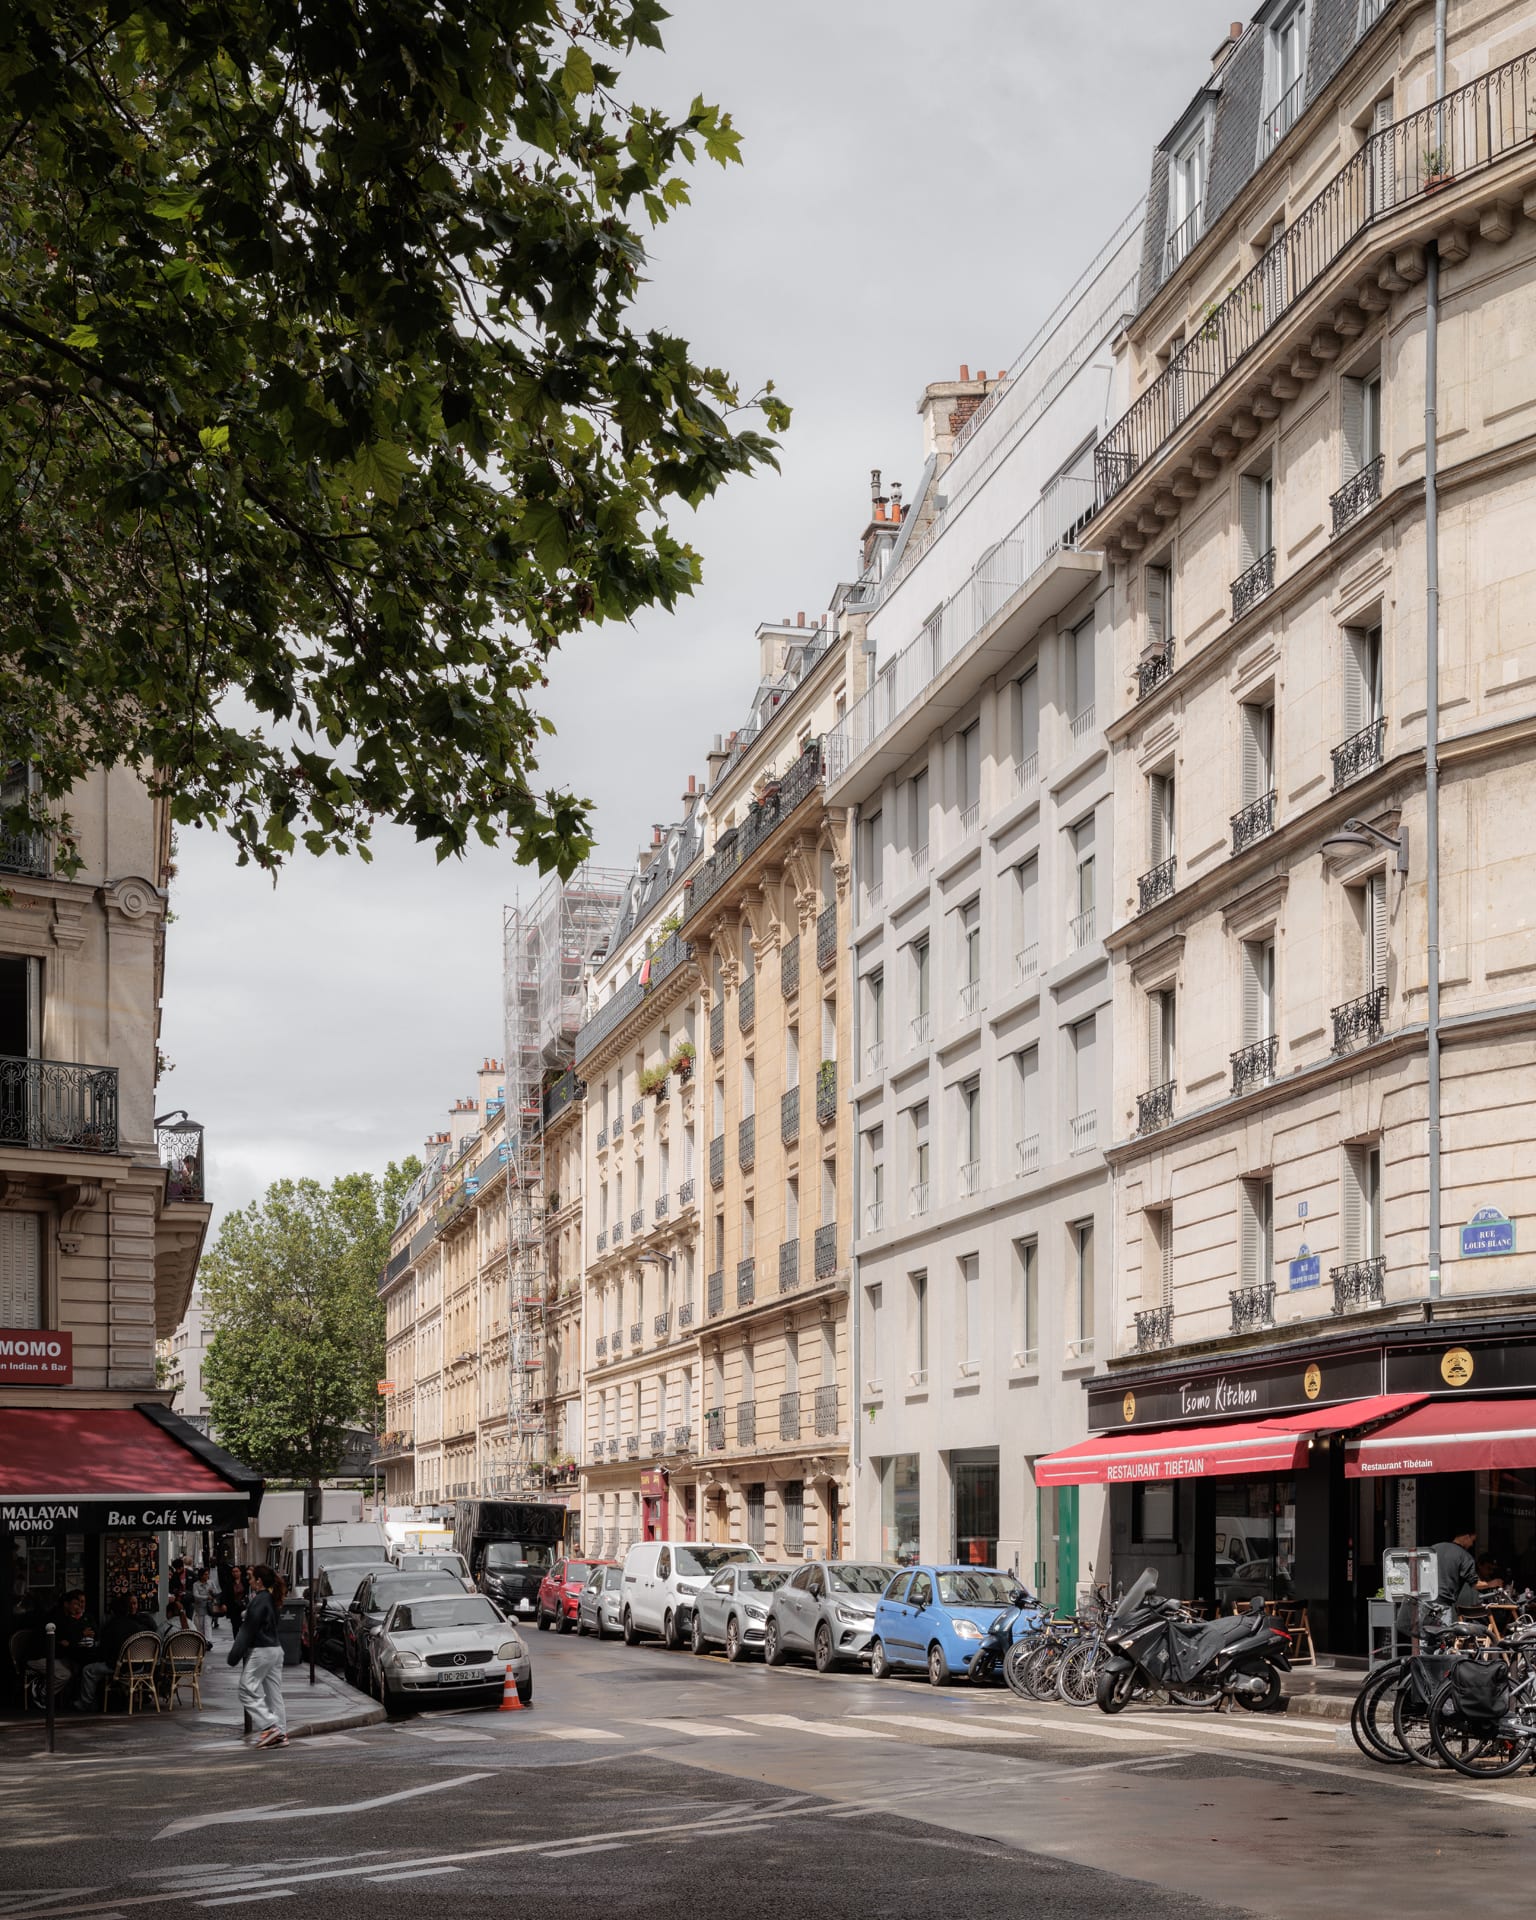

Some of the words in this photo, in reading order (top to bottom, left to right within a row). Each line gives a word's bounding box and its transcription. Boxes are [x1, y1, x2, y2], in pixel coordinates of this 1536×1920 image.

[1480, 1230, 1496, 1239] RUE
[1464, 1240, 1486, 1251] LOUIS
[1487, 1239, 1511, 1248] BLANC
[0, 1341, 61, 1357] MOMO
[9, 1362, 39, 1371] Indian
[41, 1363, 49, 1371] &
[51, 1363, 68, 1371] Bar
[1179, 1382, 1210, 1414] Tsomo
[1215, 1376, 1257, 1411] Kitchen
[1107, 1462, 1160, 1480] RESTAURANT
[1163, 1457, 1204, 1476] TIBÉTAIN
[1361, 1460, 1402, 1471] Restaurant
[1403, 1458, 1433, 1469] Tibétain
[8, 1520, 54, 1531] MOMO
